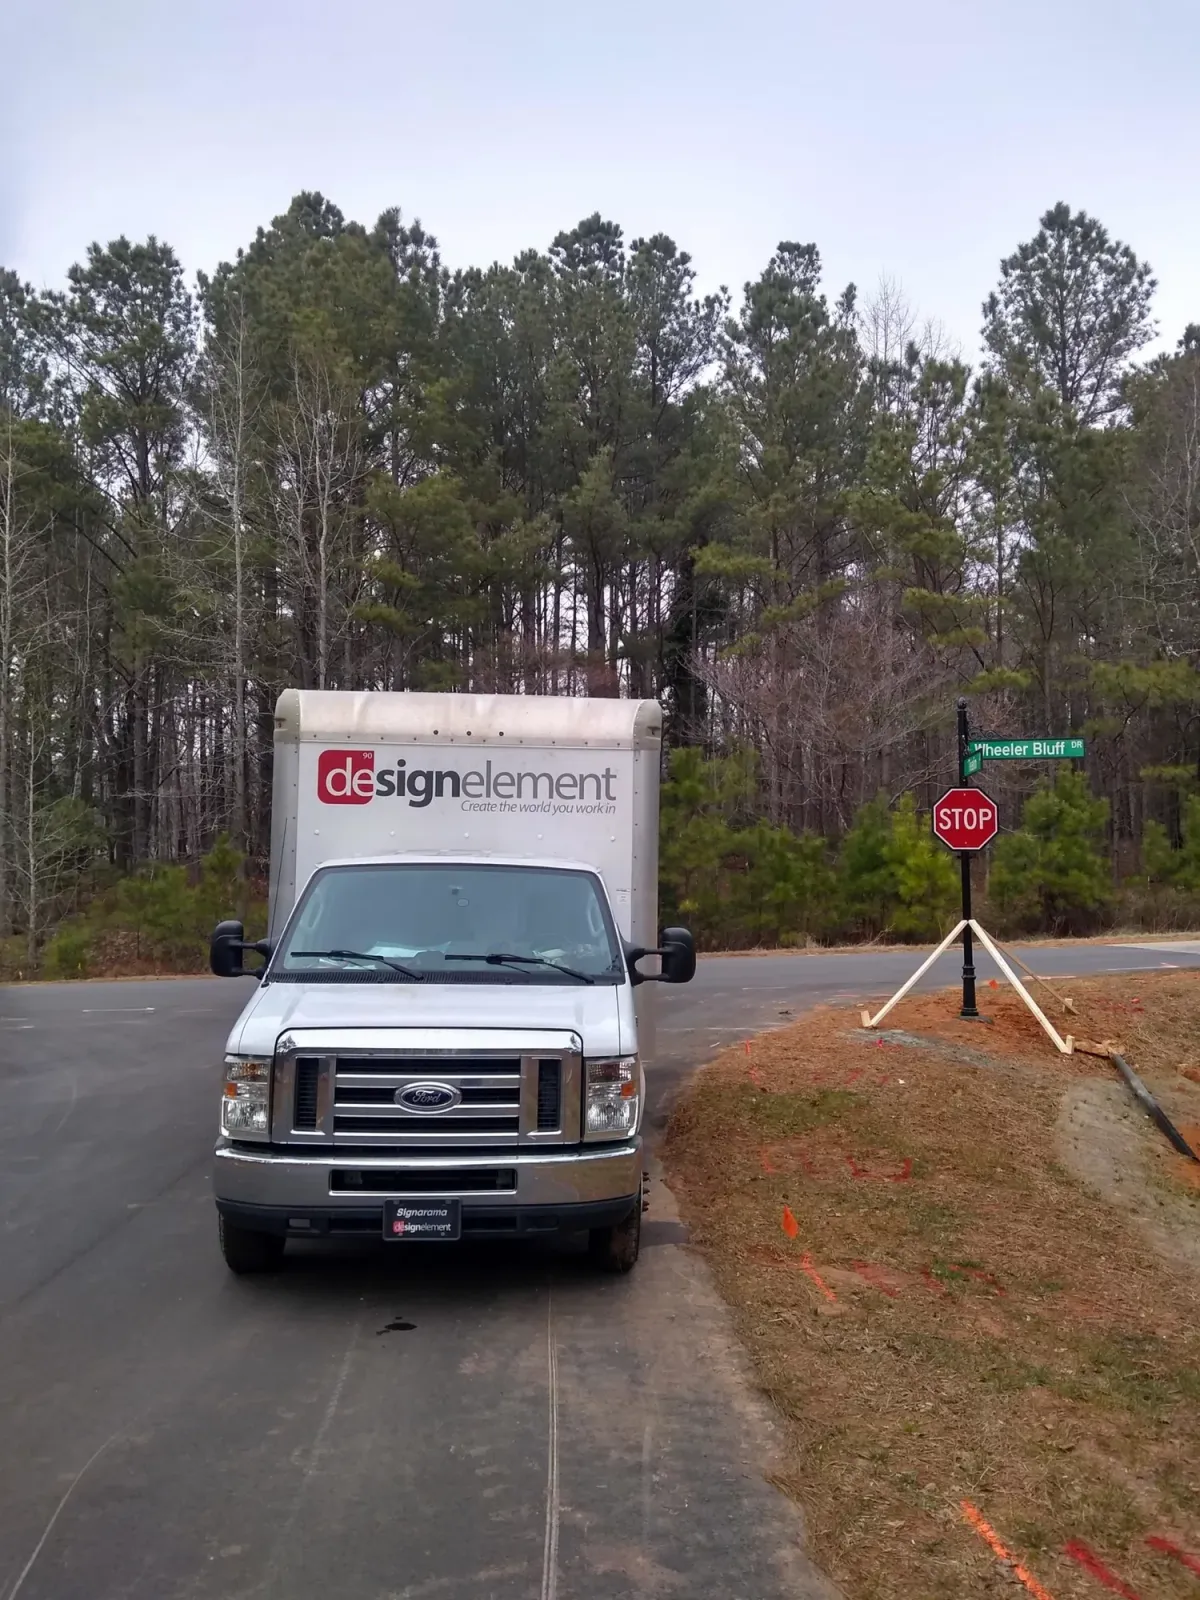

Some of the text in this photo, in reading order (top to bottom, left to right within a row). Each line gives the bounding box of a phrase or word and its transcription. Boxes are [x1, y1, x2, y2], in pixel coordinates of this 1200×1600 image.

[1032, 741, 1065, 755] Bluff
[1071, 740, 1083, 749] DR
[362, 752, 373, 760] 90
[461, 800, 616, 816] Create the world you work in
[939, 808, 993, 830] STOP
[412, 1089, 442, 1103] Ford
[396, 1207, 448, 1219] Signarama
[393, 1221, 451, 1233] designelement
